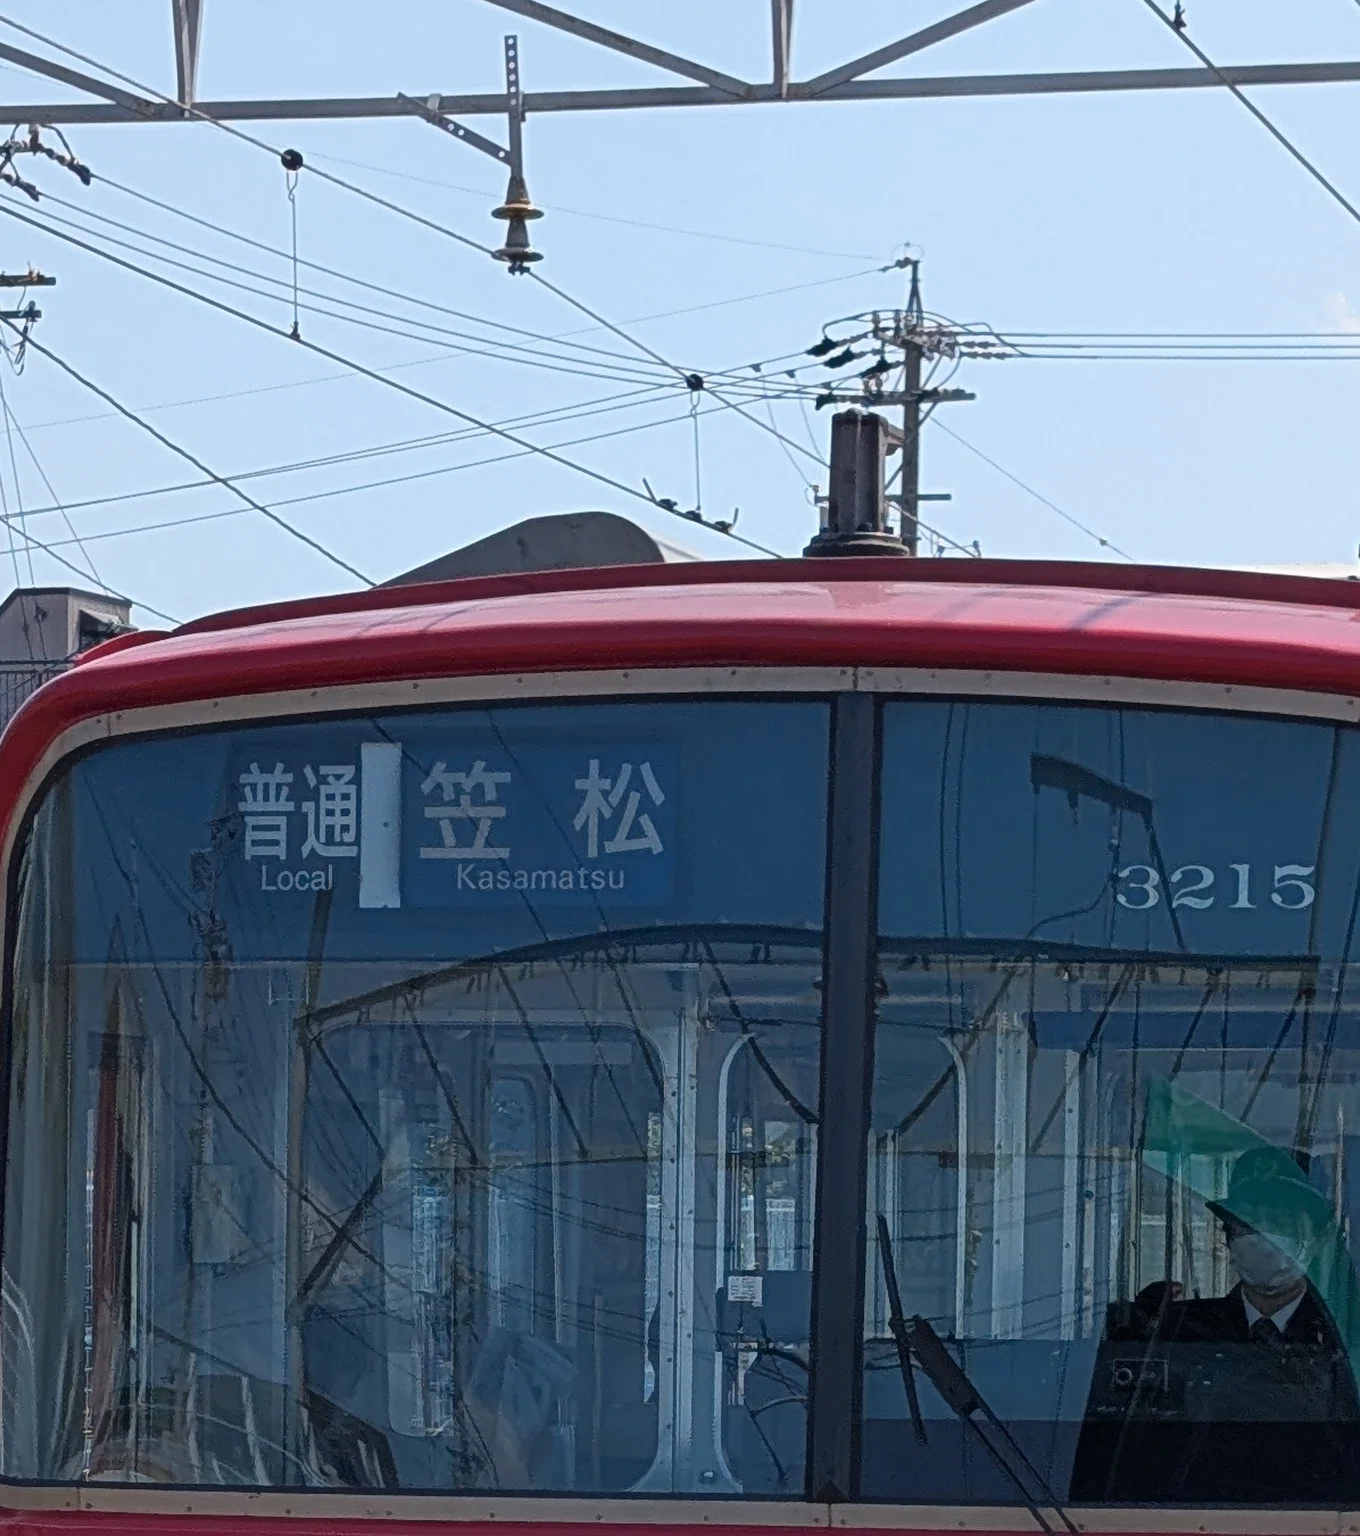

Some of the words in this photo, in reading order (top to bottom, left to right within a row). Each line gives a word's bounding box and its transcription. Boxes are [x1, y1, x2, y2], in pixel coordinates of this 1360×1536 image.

[238, 761, 360, 861] 普通
[418, 757, 666, 860] 笠松
[260, 863, 334, 892] Local
[456, 862, 626, 892] Kasamatsu
[1115, 862, 1316, 910] 3215
